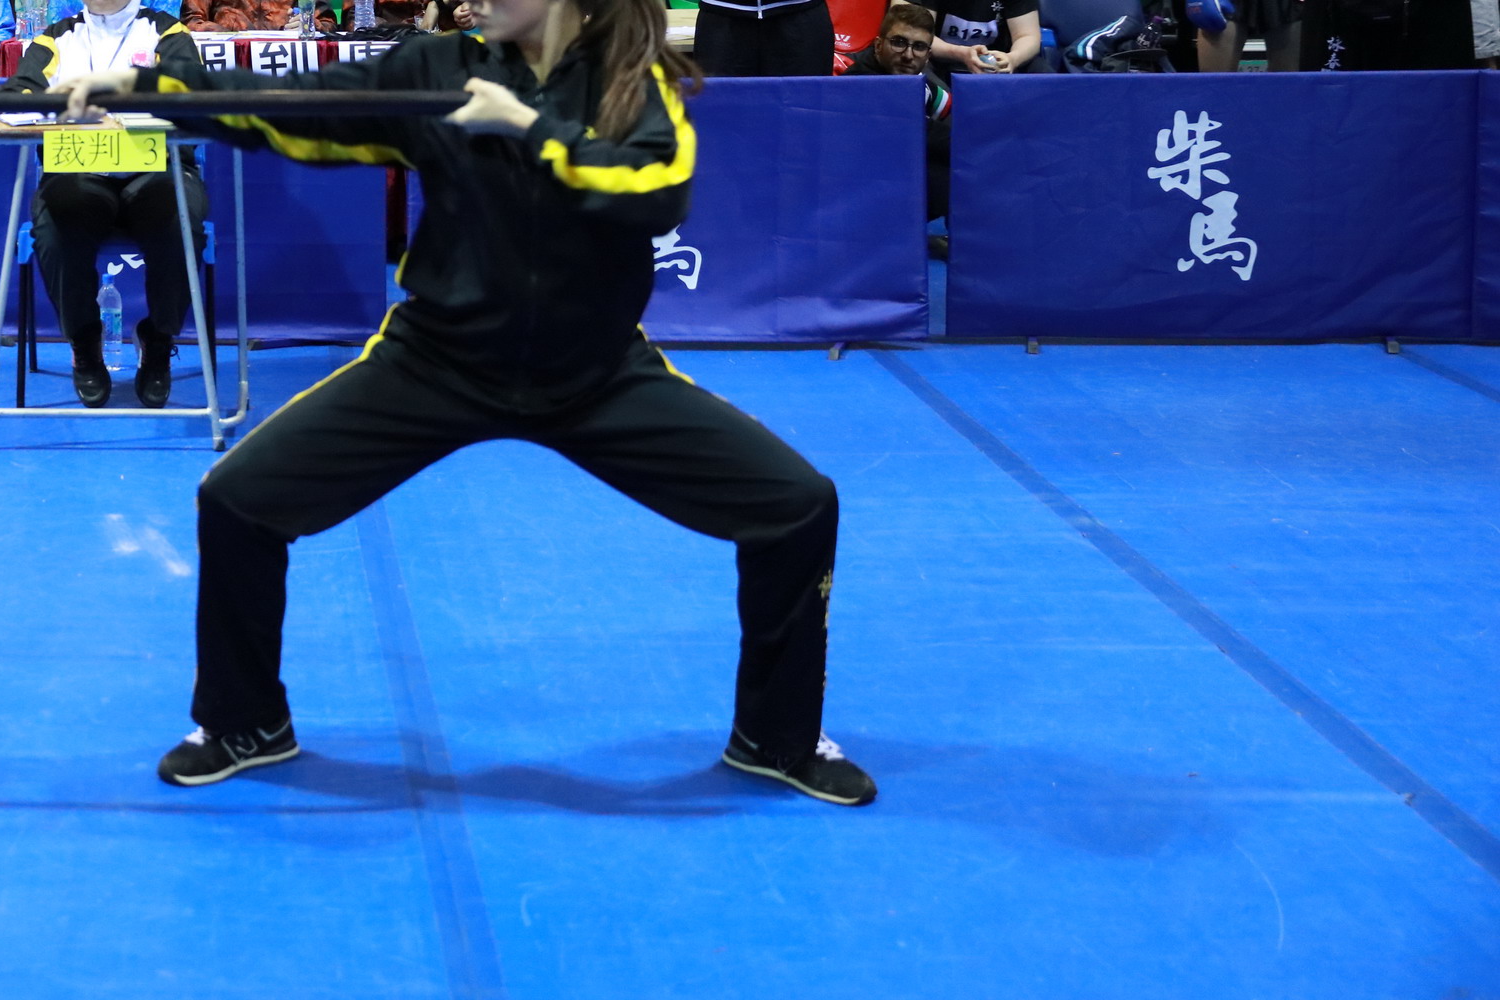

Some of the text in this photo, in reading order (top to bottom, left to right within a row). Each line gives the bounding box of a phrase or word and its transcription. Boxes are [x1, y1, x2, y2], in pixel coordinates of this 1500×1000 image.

[948, 25, 992, 41] 8121
[52, 132, 159, 168] 裁判 3
[1148, 111, 1257, 281] 柴馬
